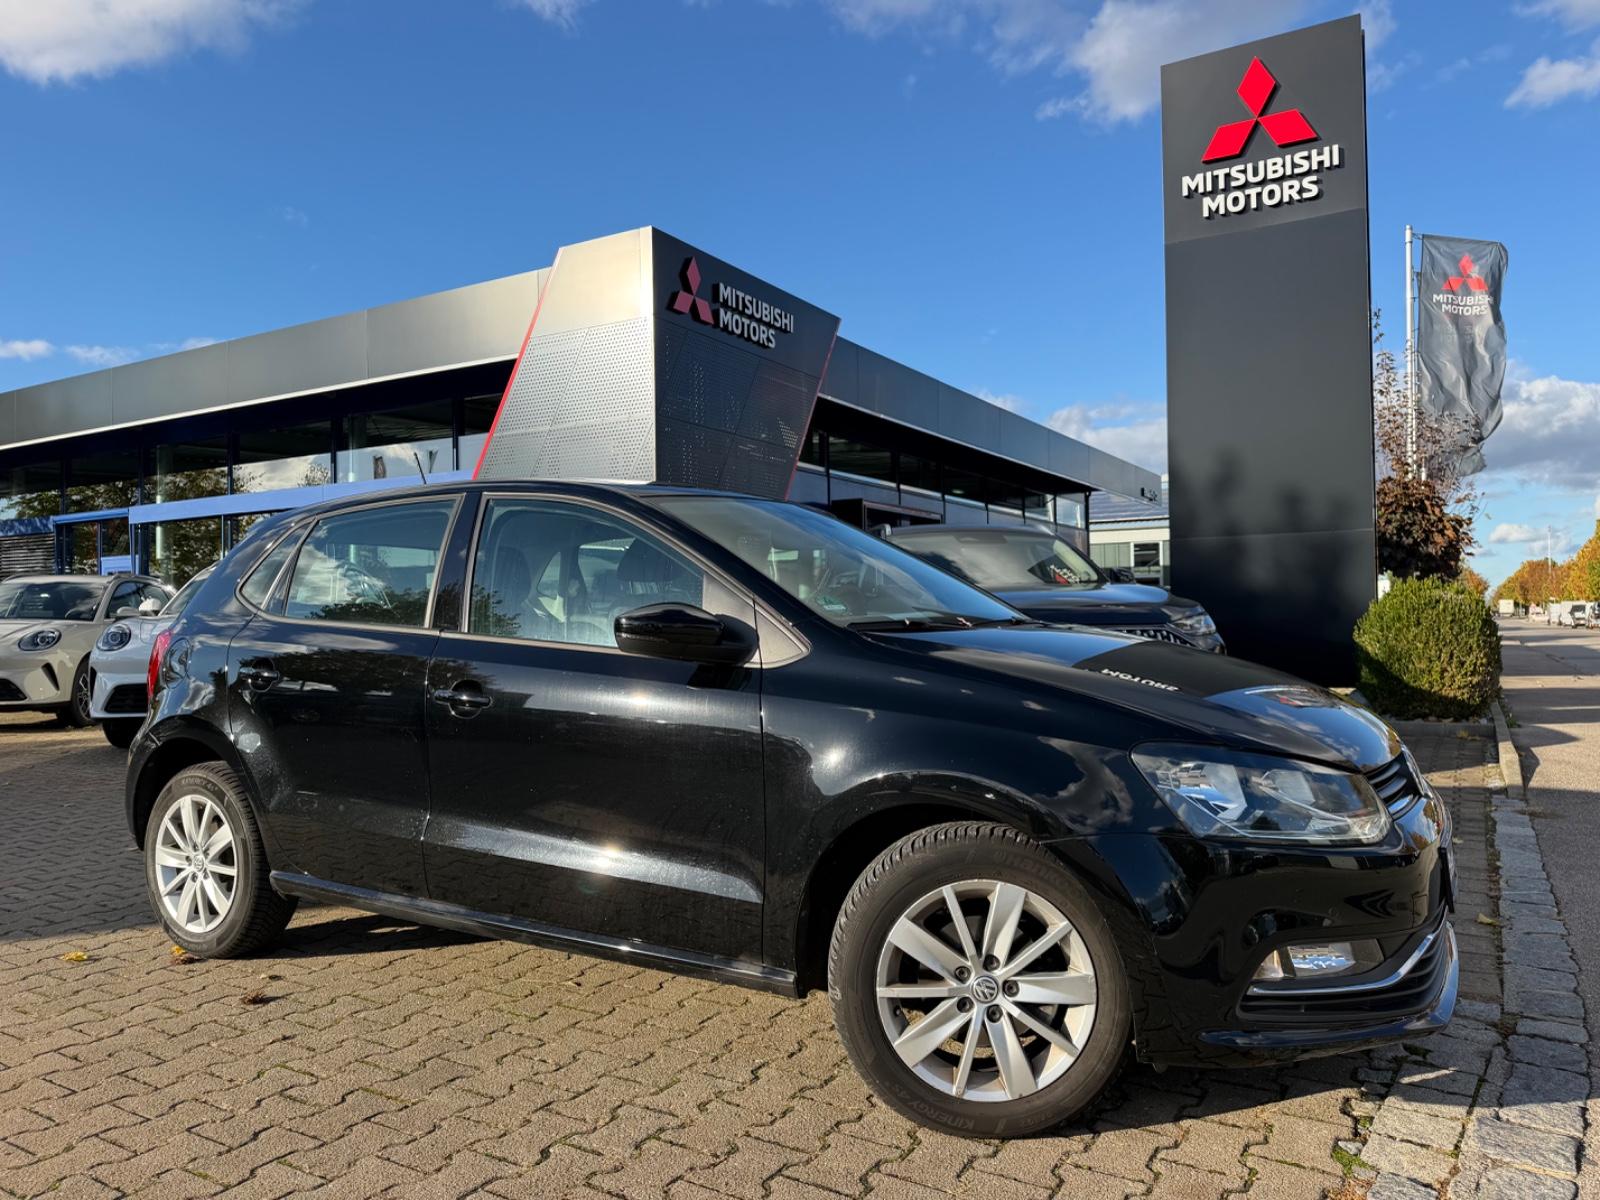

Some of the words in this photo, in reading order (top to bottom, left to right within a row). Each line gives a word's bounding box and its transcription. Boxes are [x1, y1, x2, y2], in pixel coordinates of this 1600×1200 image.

[1181, 144, 1340, 197] MITSUBISHI
[1202, 175, 1319, 218] MOTORS
[718, 282, 794, 333] MITSUBISHI
[1433, 294, 1494, 305] MITSUBISH
[1442, 304, 1488, 316] MOTORS
[718, 308, 776, 349] MOTORS
